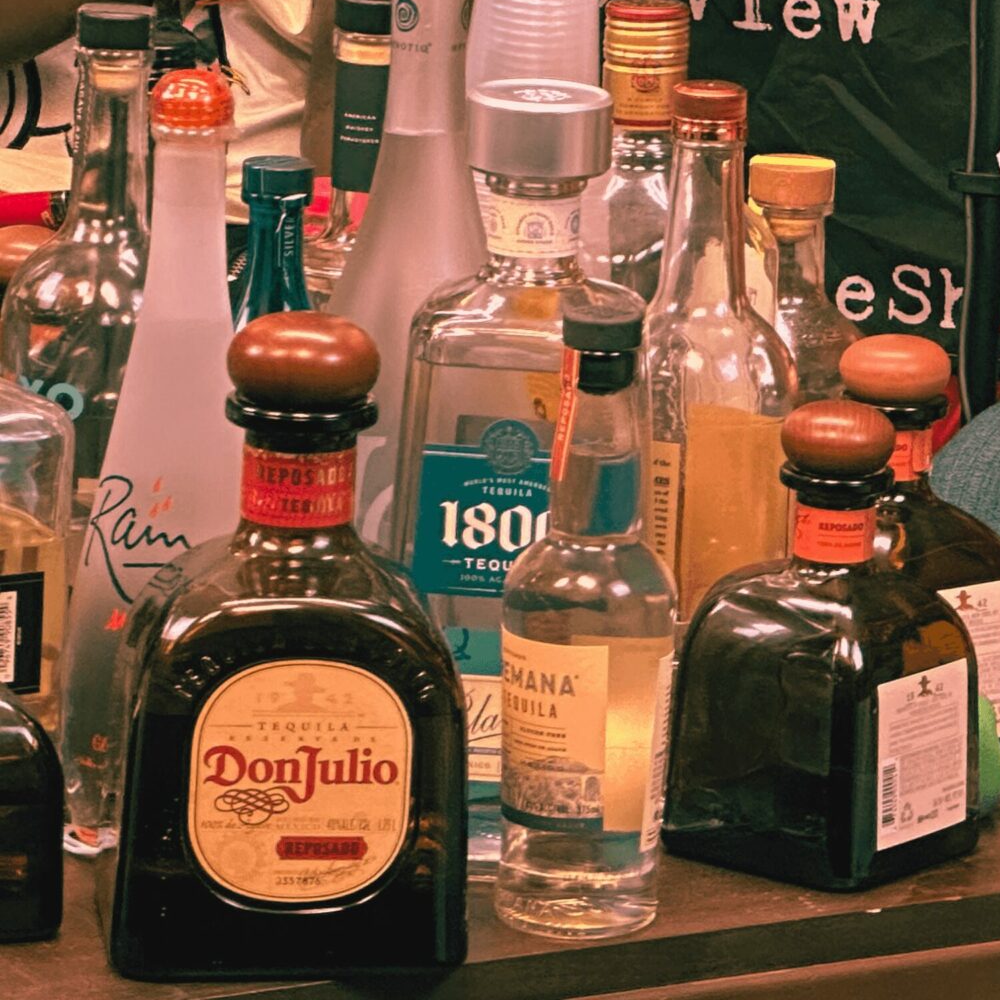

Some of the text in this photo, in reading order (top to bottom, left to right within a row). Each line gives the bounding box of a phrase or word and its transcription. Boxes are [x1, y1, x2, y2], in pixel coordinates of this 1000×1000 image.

[481, 486, 533, 498] TEQUILA
[818, 522, 864, 532] REPOSADO
[257, 721, 349, 733] TEQUILA
